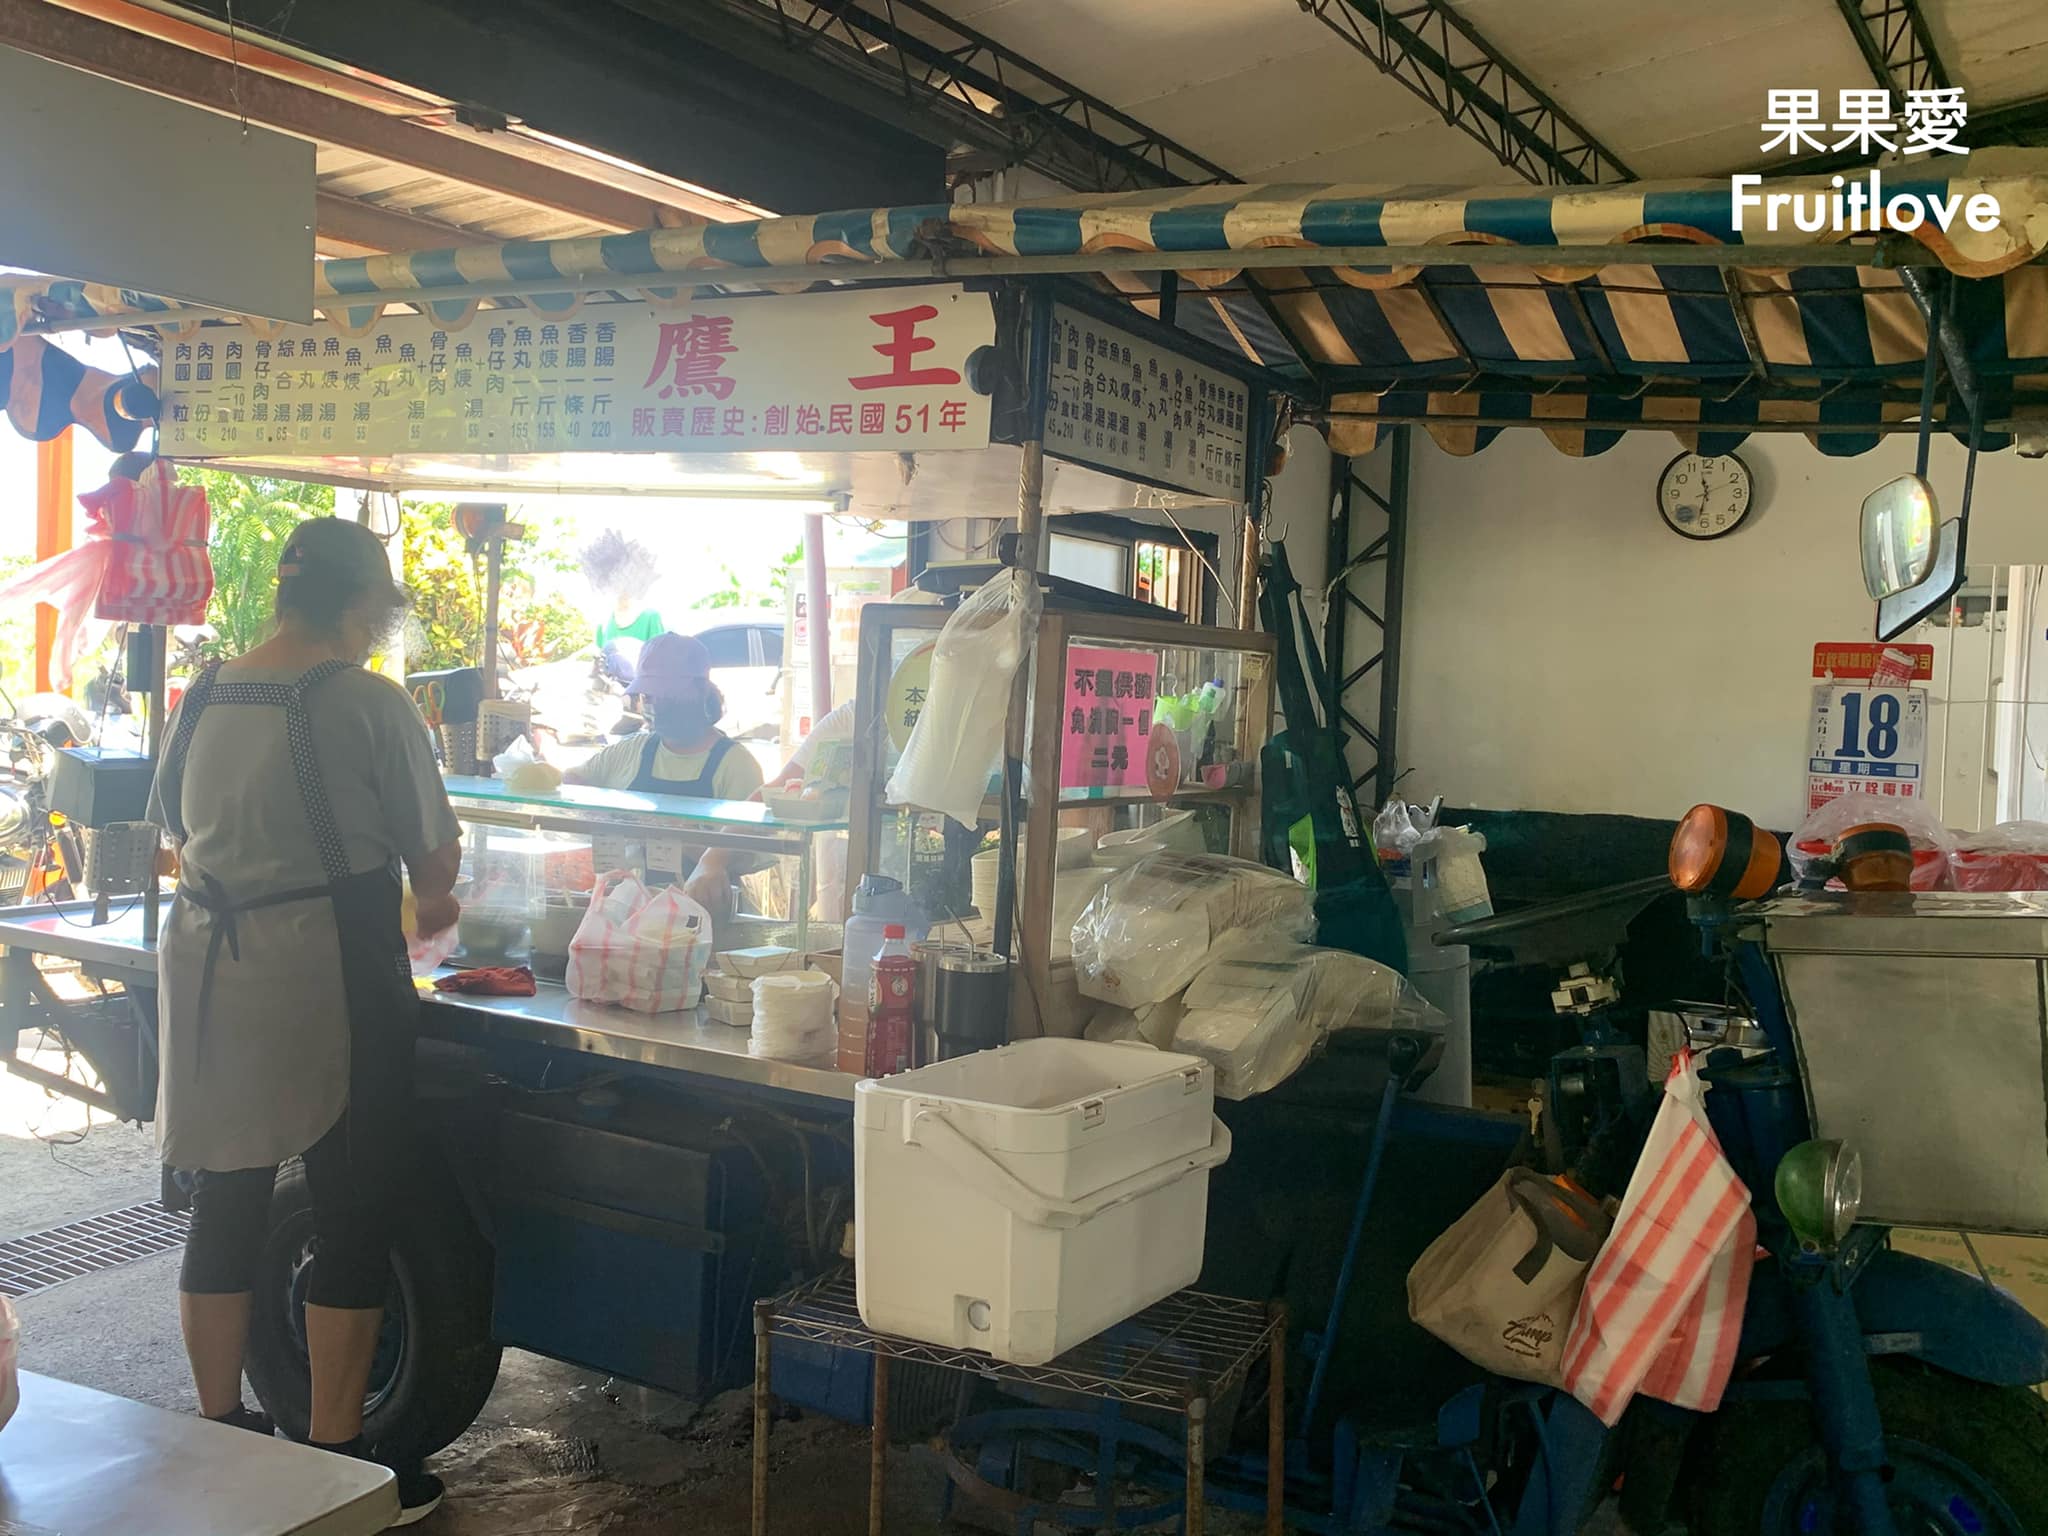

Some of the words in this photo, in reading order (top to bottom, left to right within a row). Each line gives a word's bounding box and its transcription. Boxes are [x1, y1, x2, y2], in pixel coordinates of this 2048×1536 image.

[173, 343, 191, 422] 肉圓一粒
[195, 342, 214, 422] 肉圓一份
[252, 341, 272, 422] 骨仔肉湯
[296, 338, 317, 422] 魚丸湯
[1835, 693, 1900, 759] 18
